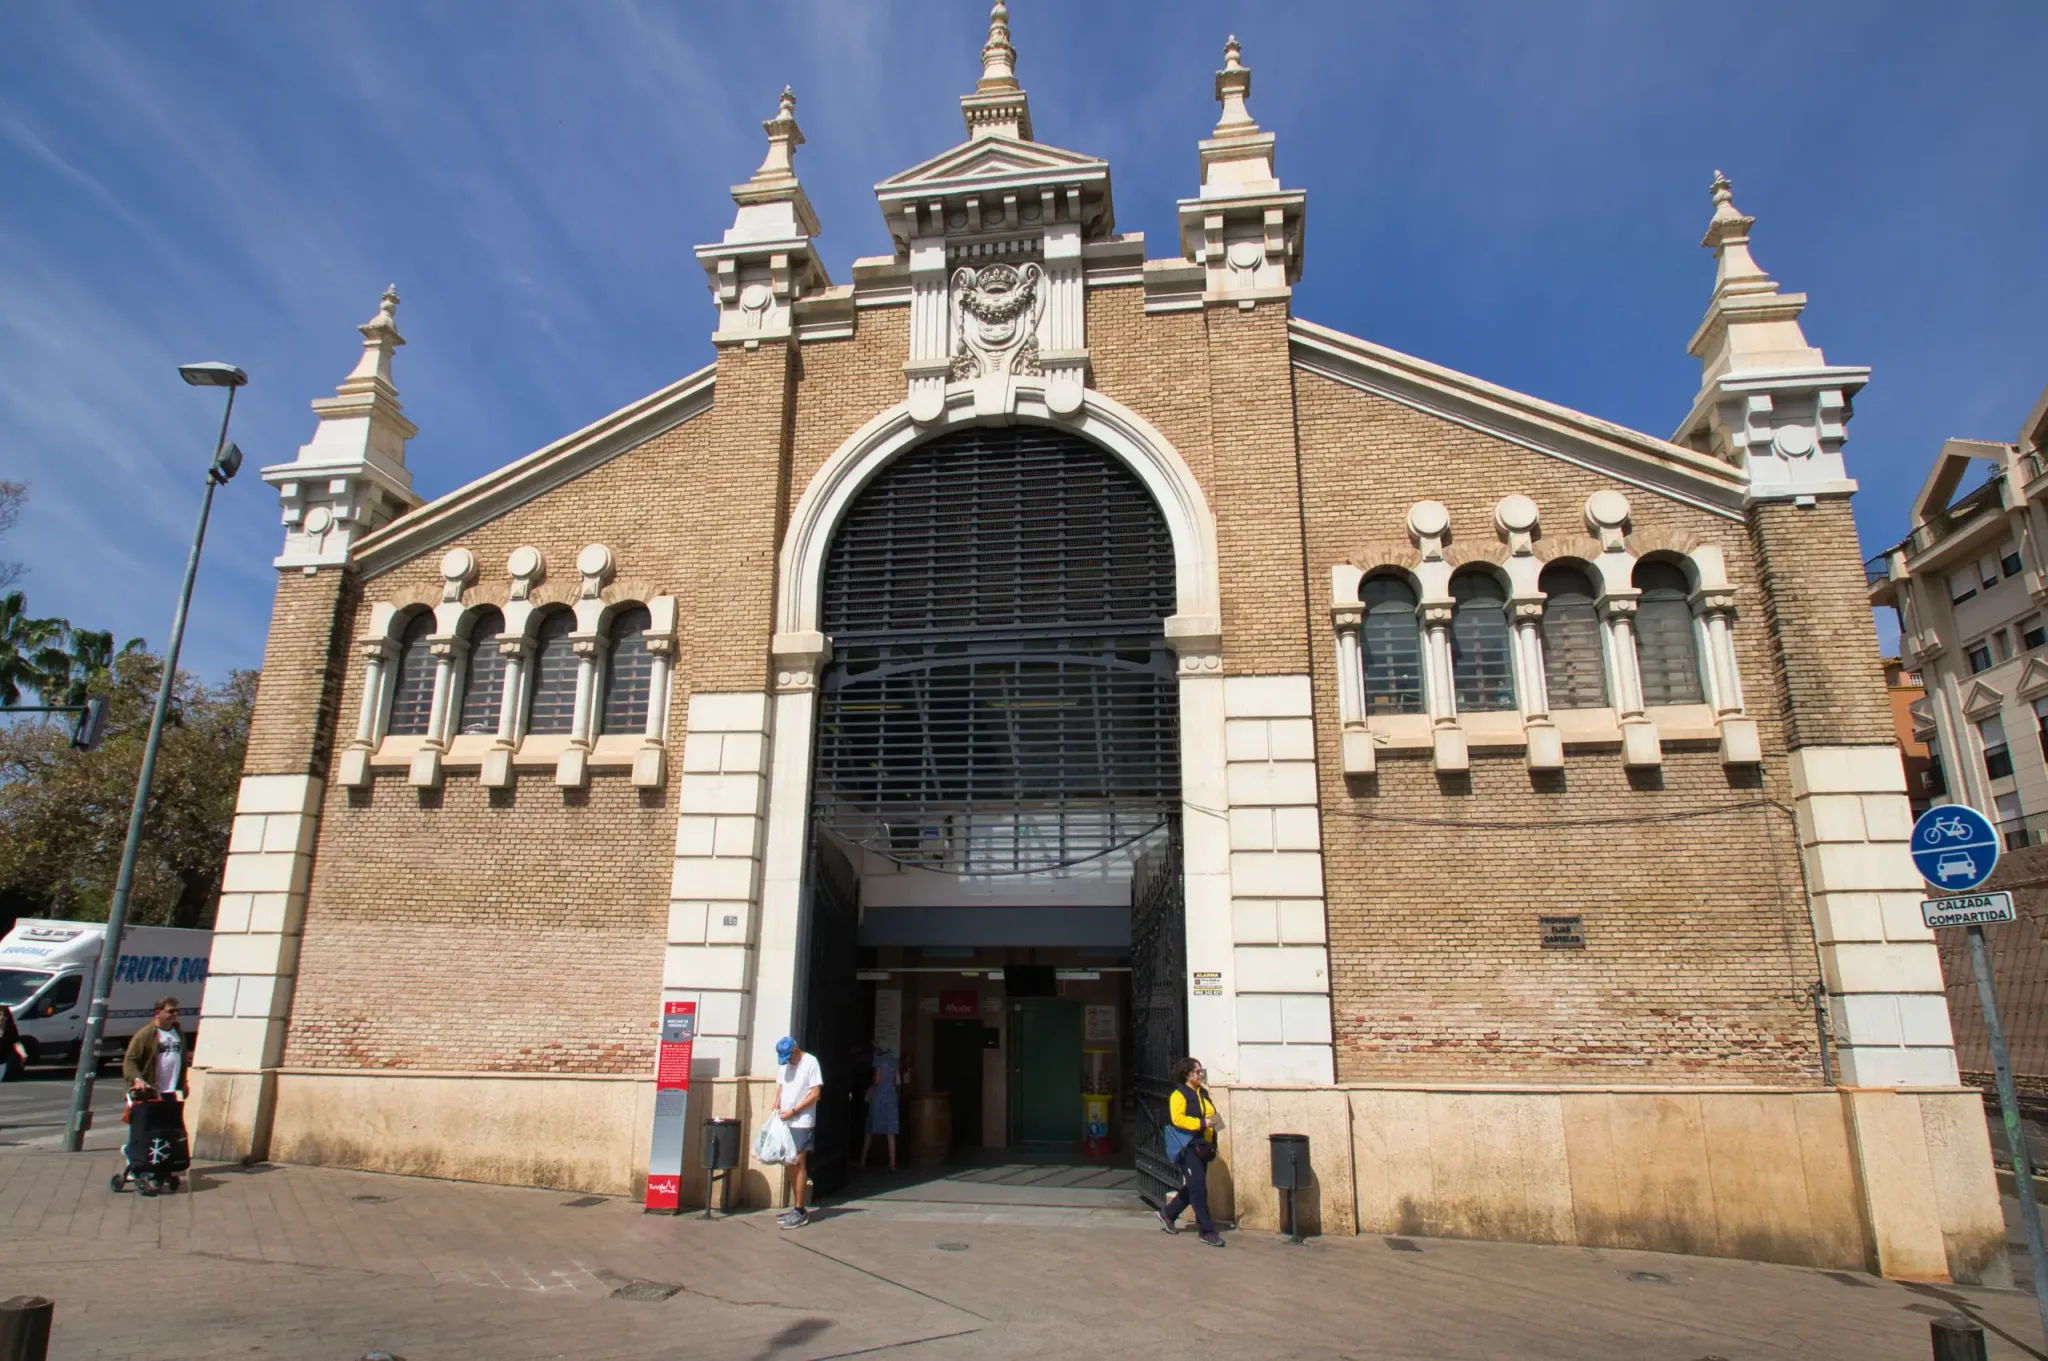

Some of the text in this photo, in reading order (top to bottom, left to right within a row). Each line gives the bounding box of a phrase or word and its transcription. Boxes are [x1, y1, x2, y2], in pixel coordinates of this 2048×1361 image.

[1936, 897, 1992, 911] CALZADA
[1928, 909, 2007, 925] COMPARTIDA
[1551, 926, 1571, 934] FIJAR
[114, 955, 179, 984] FRUTAS
